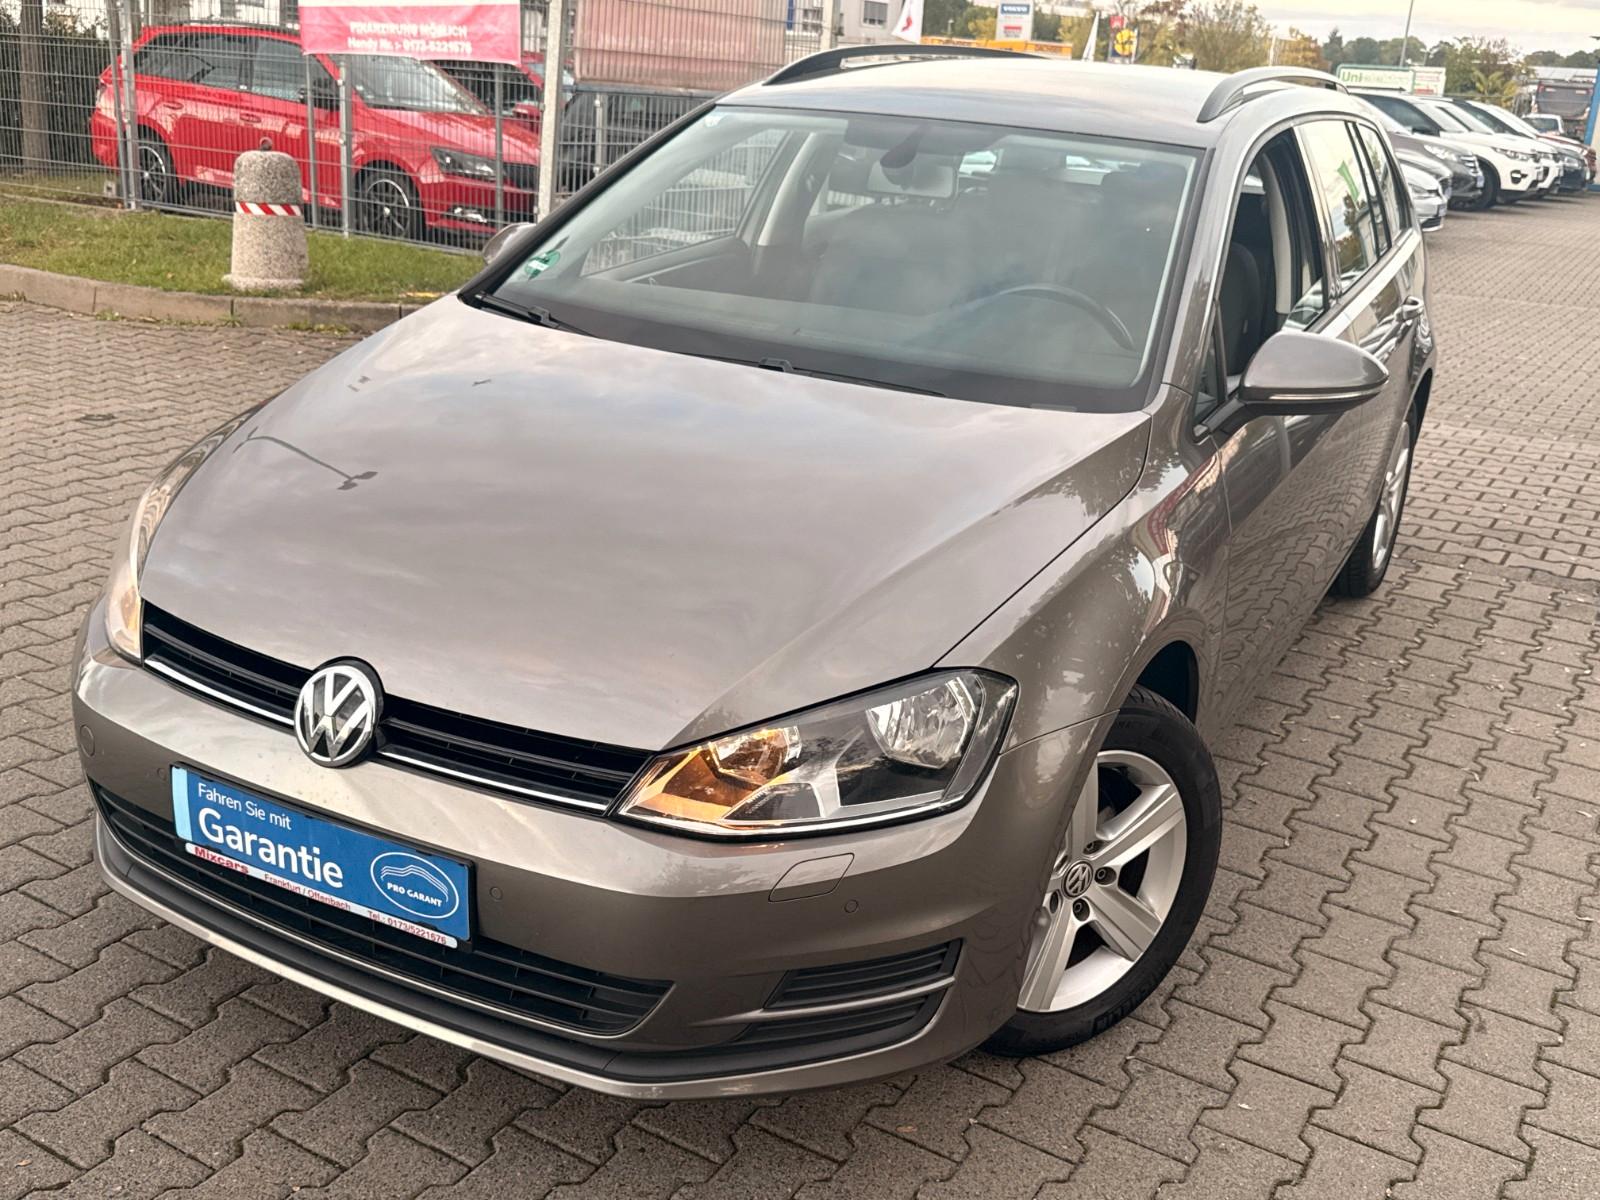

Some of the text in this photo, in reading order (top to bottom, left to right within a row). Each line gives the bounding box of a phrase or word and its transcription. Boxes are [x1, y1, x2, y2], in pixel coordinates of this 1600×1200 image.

[198, 782, 292, 830] Fahren Sie mit
[194, 846, 249, 874] Mixcars
[198, 807, 343, 888] Garantie
[307, 889, 351, 910] Offenbach
[387, 882, 442, 907] PRO GARANT
